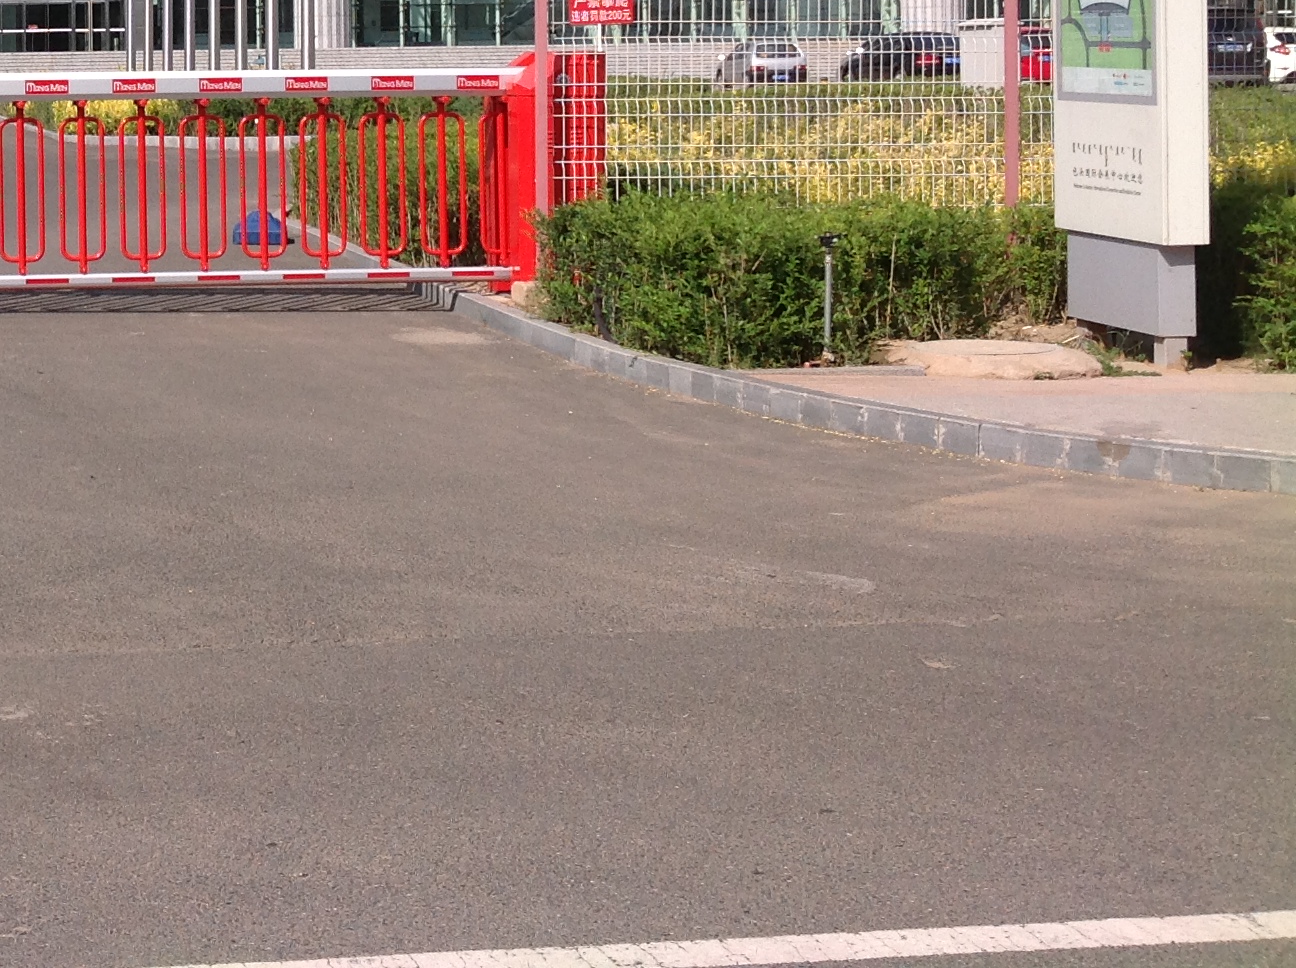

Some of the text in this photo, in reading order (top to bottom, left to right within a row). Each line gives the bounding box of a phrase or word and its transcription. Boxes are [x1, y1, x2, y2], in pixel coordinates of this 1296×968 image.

[571, 9, 632, 23] 违者罚款200元
